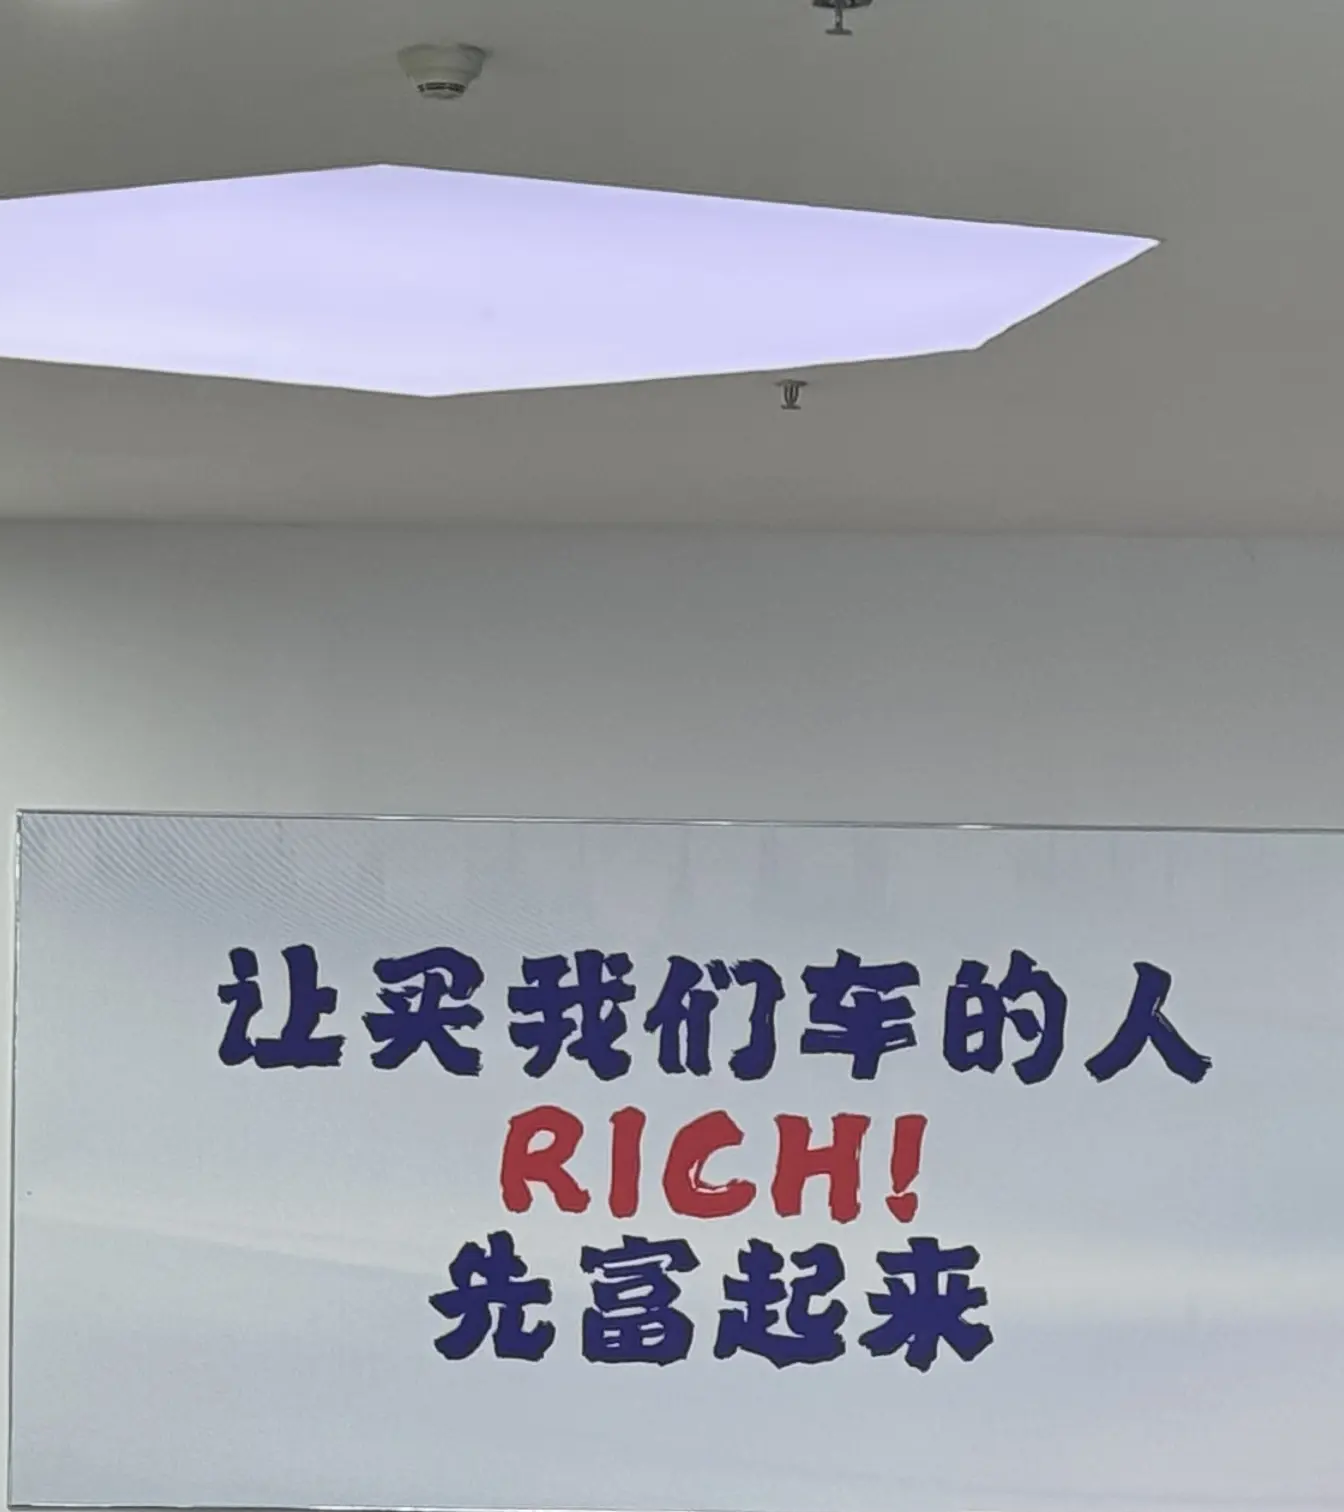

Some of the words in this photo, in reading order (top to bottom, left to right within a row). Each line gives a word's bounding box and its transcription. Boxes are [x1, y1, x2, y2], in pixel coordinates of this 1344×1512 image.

[216, 946, 1213, 1084] 让买我们车的人
[499, 1105, 929, 1223] RICH!
[429, 1231, 996, 1374] 先富起来
